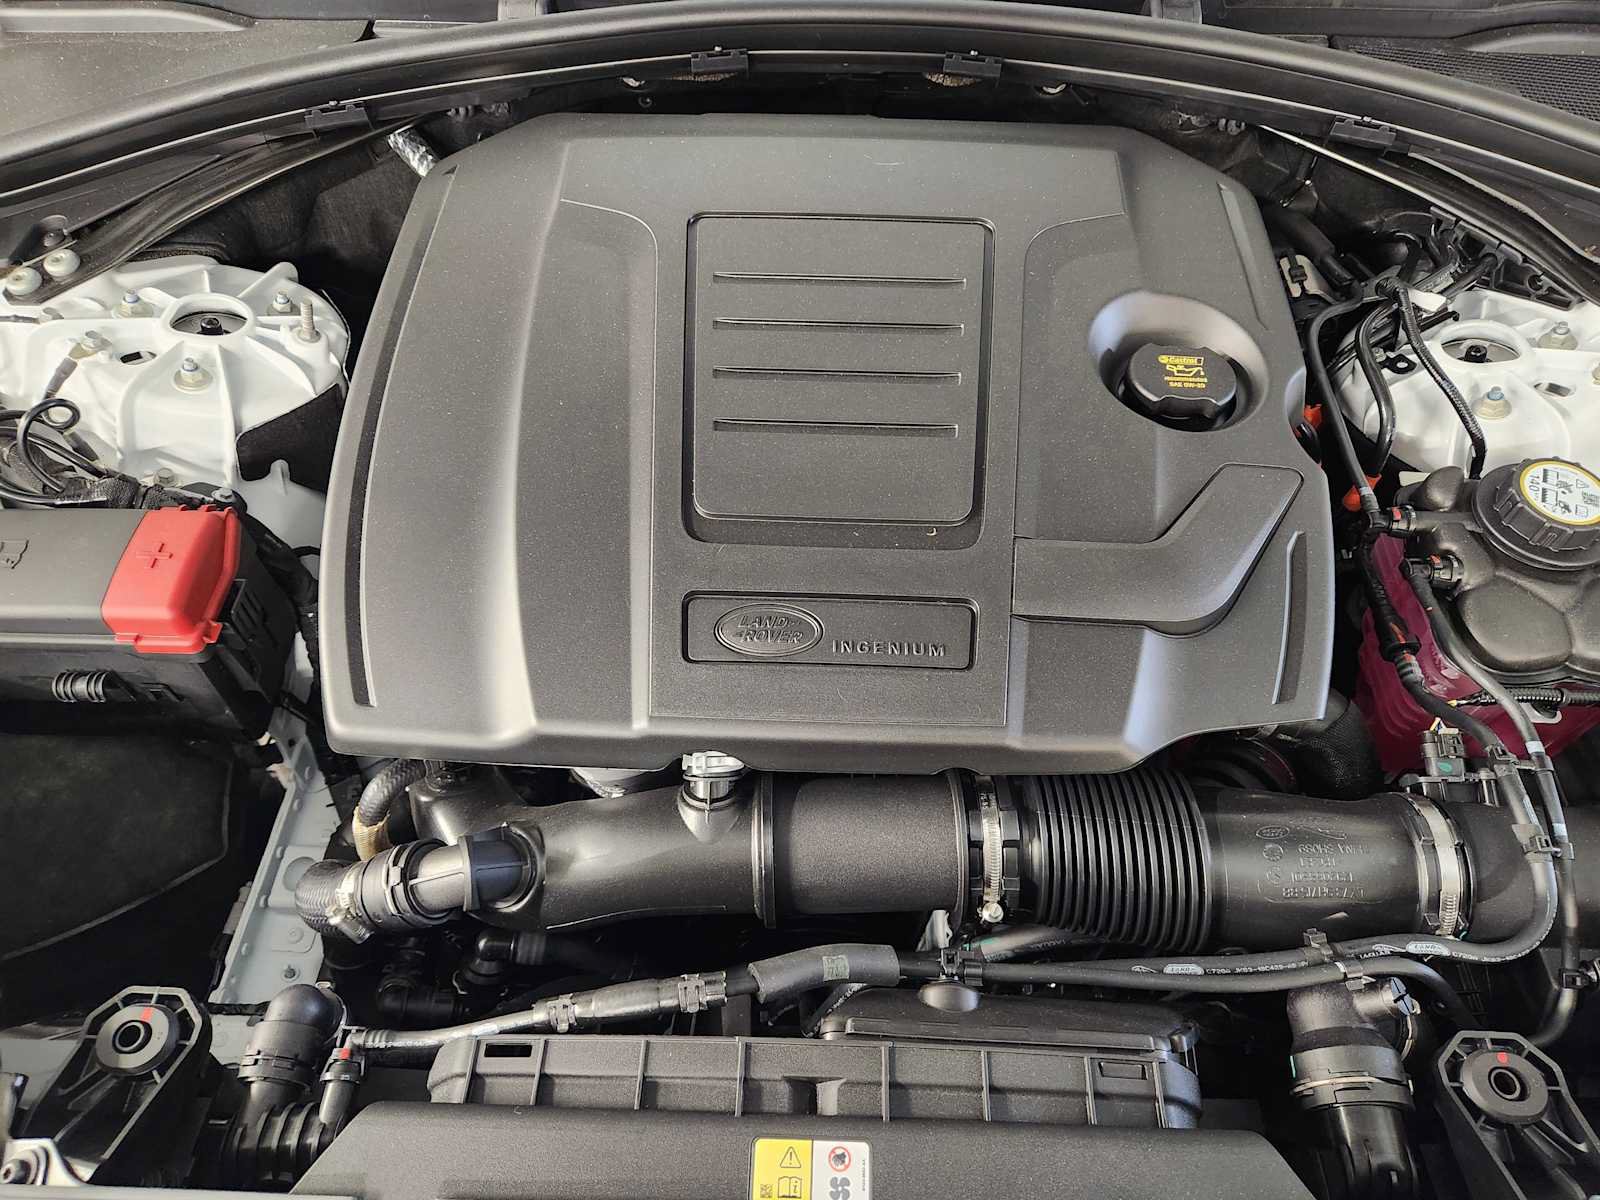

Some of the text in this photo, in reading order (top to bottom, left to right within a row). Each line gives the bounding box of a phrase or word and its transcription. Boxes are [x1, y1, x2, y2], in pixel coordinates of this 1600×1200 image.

[737, 614, 789, 629] LAND
[742, 629, 803, 645] ROVER
[831, 639, 947, 657] INGENIUM
